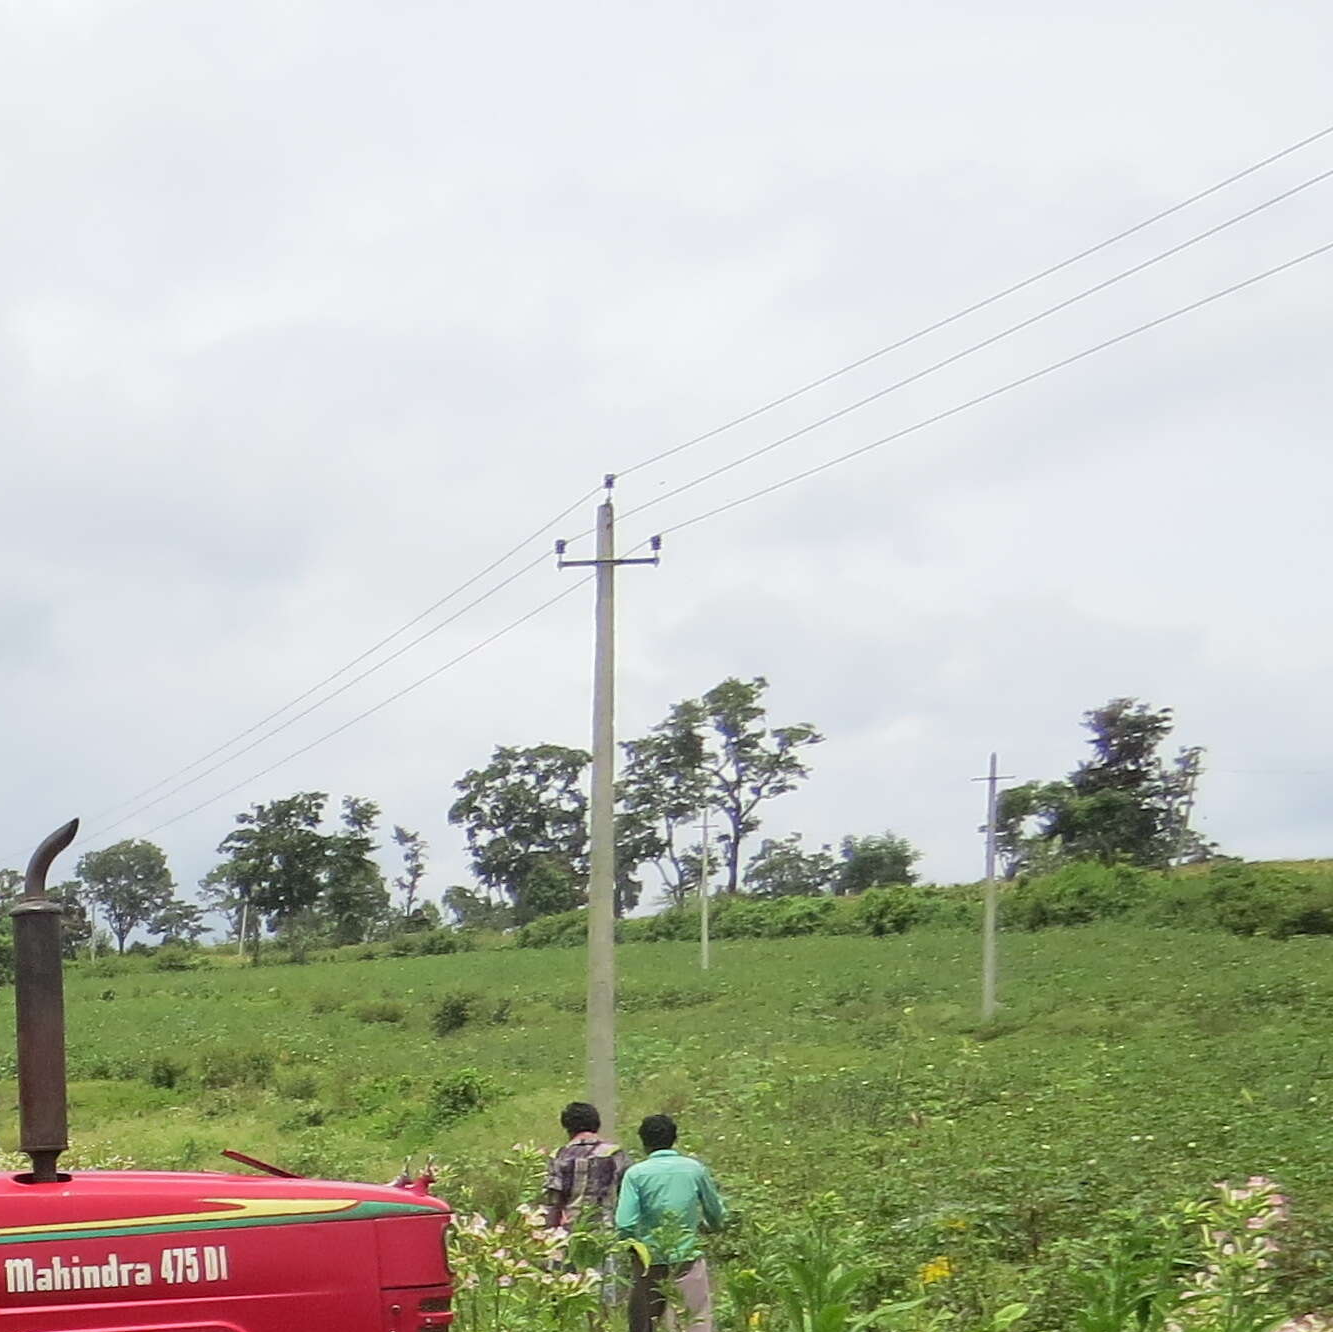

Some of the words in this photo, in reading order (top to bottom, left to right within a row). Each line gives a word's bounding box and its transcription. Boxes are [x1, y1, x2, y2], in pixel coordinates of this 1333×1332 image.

[5, 1252, 152, 1293] Mahindra
[160, 1247, 199, 1284] 475
[203, 1245, 229, 1282] DI
